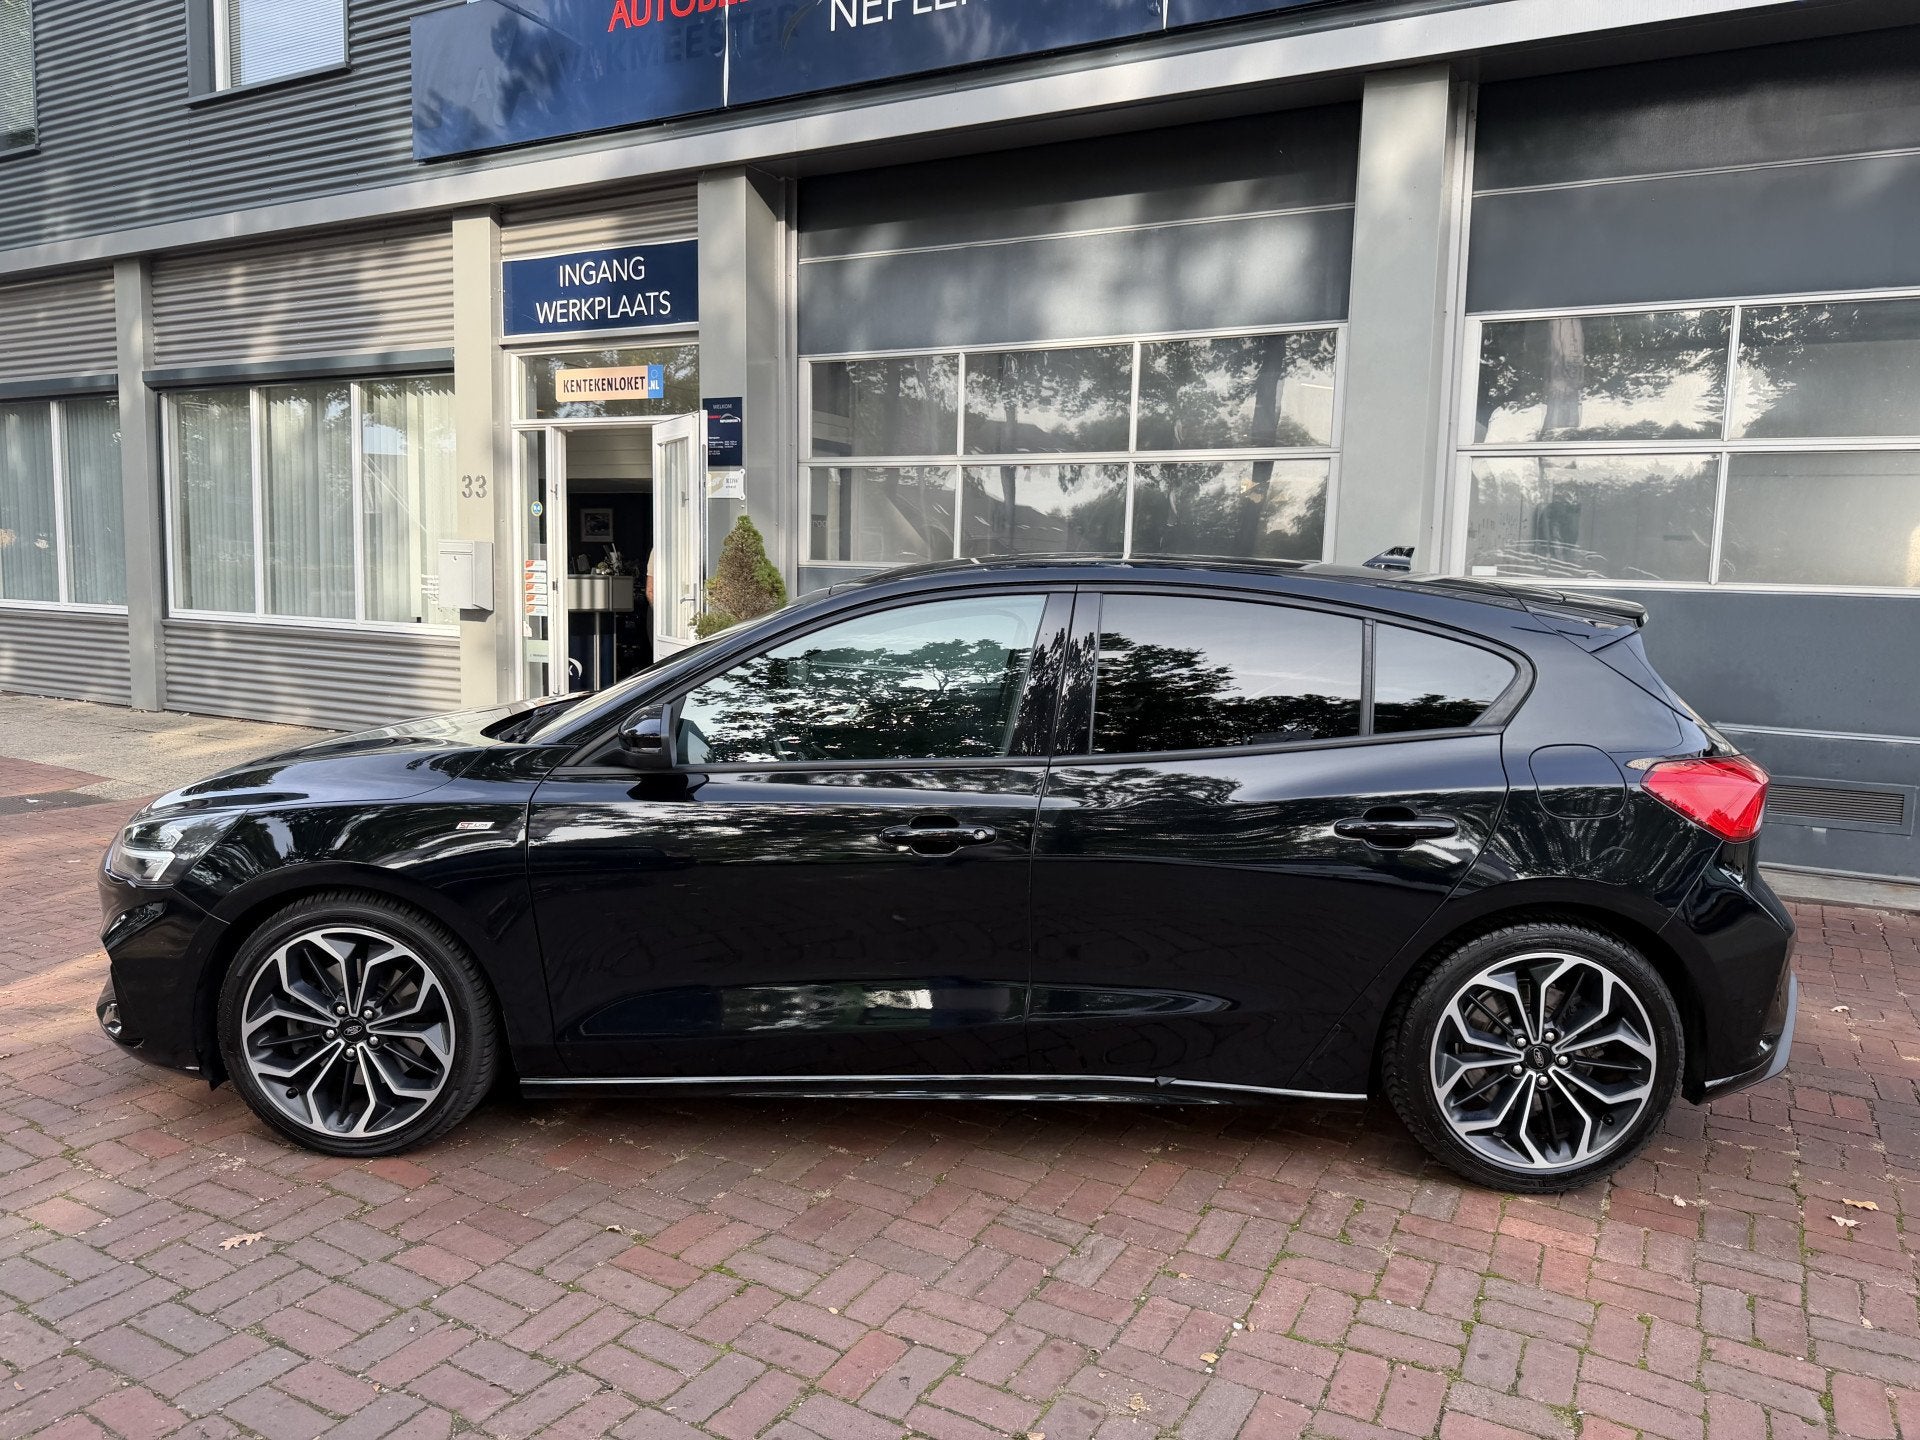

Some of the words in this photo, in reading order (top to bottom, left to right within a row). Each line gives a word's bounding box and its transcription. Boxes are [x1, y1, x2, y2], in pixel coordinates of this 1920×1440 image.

[559, 256, 645, 288] INGANG
[535, 290, 671, 324] WERKPLAATS
[563, 376, 646, 393] KENTEKENLOKET
[461, 474, 488, 499] 33
